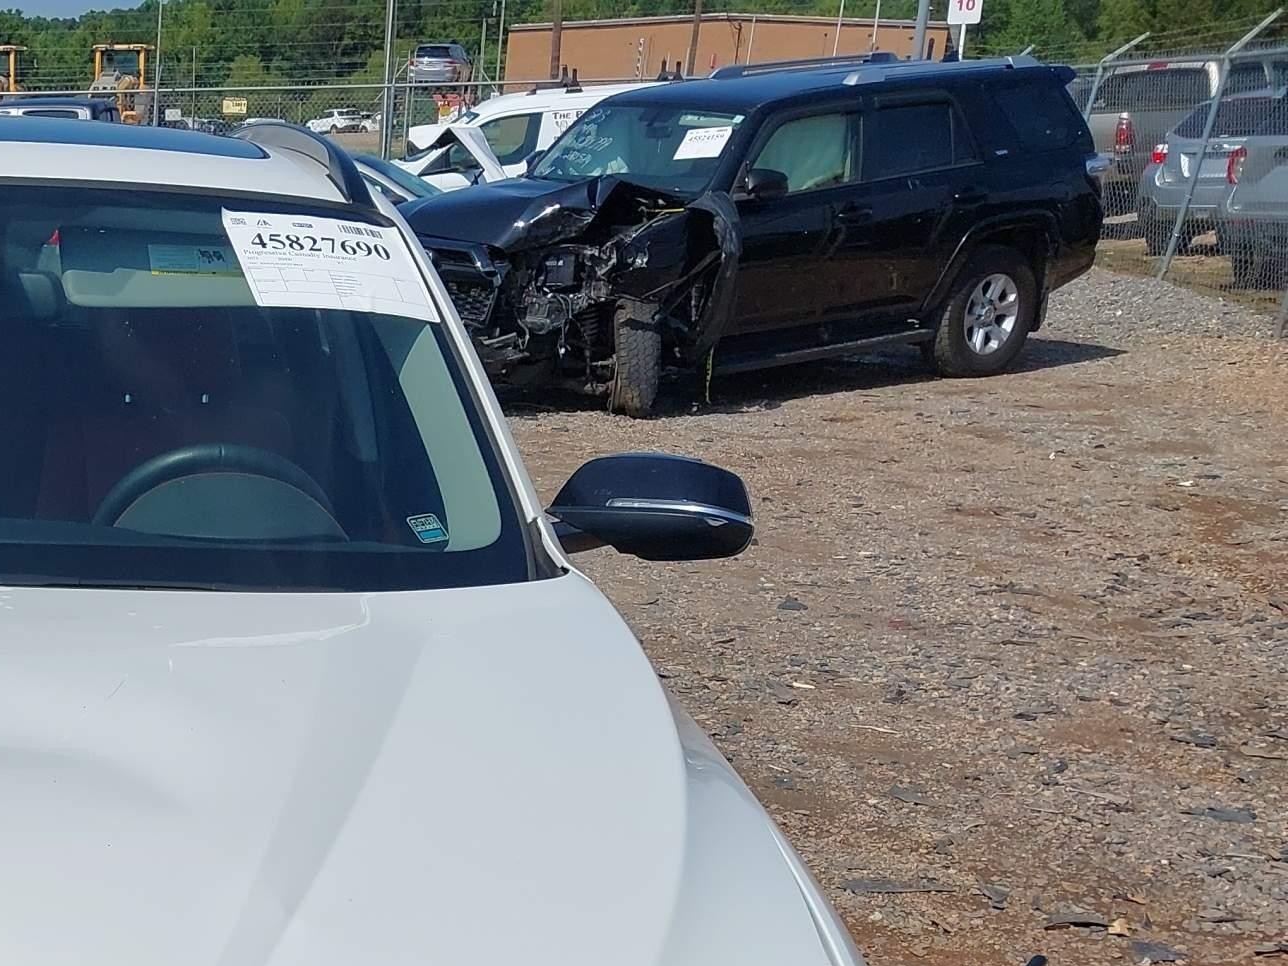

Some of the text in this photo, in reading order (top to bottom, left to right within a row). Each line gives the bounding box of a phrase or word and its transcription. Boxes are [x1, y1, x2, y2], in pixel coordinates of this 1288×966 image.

[957, 0, 976, 11] 10
[552, 112, 571, 120] THE
[251, 232, 391, 261] 45827690
[243, 248, 358, 262] Progressive Casualty Insurance
